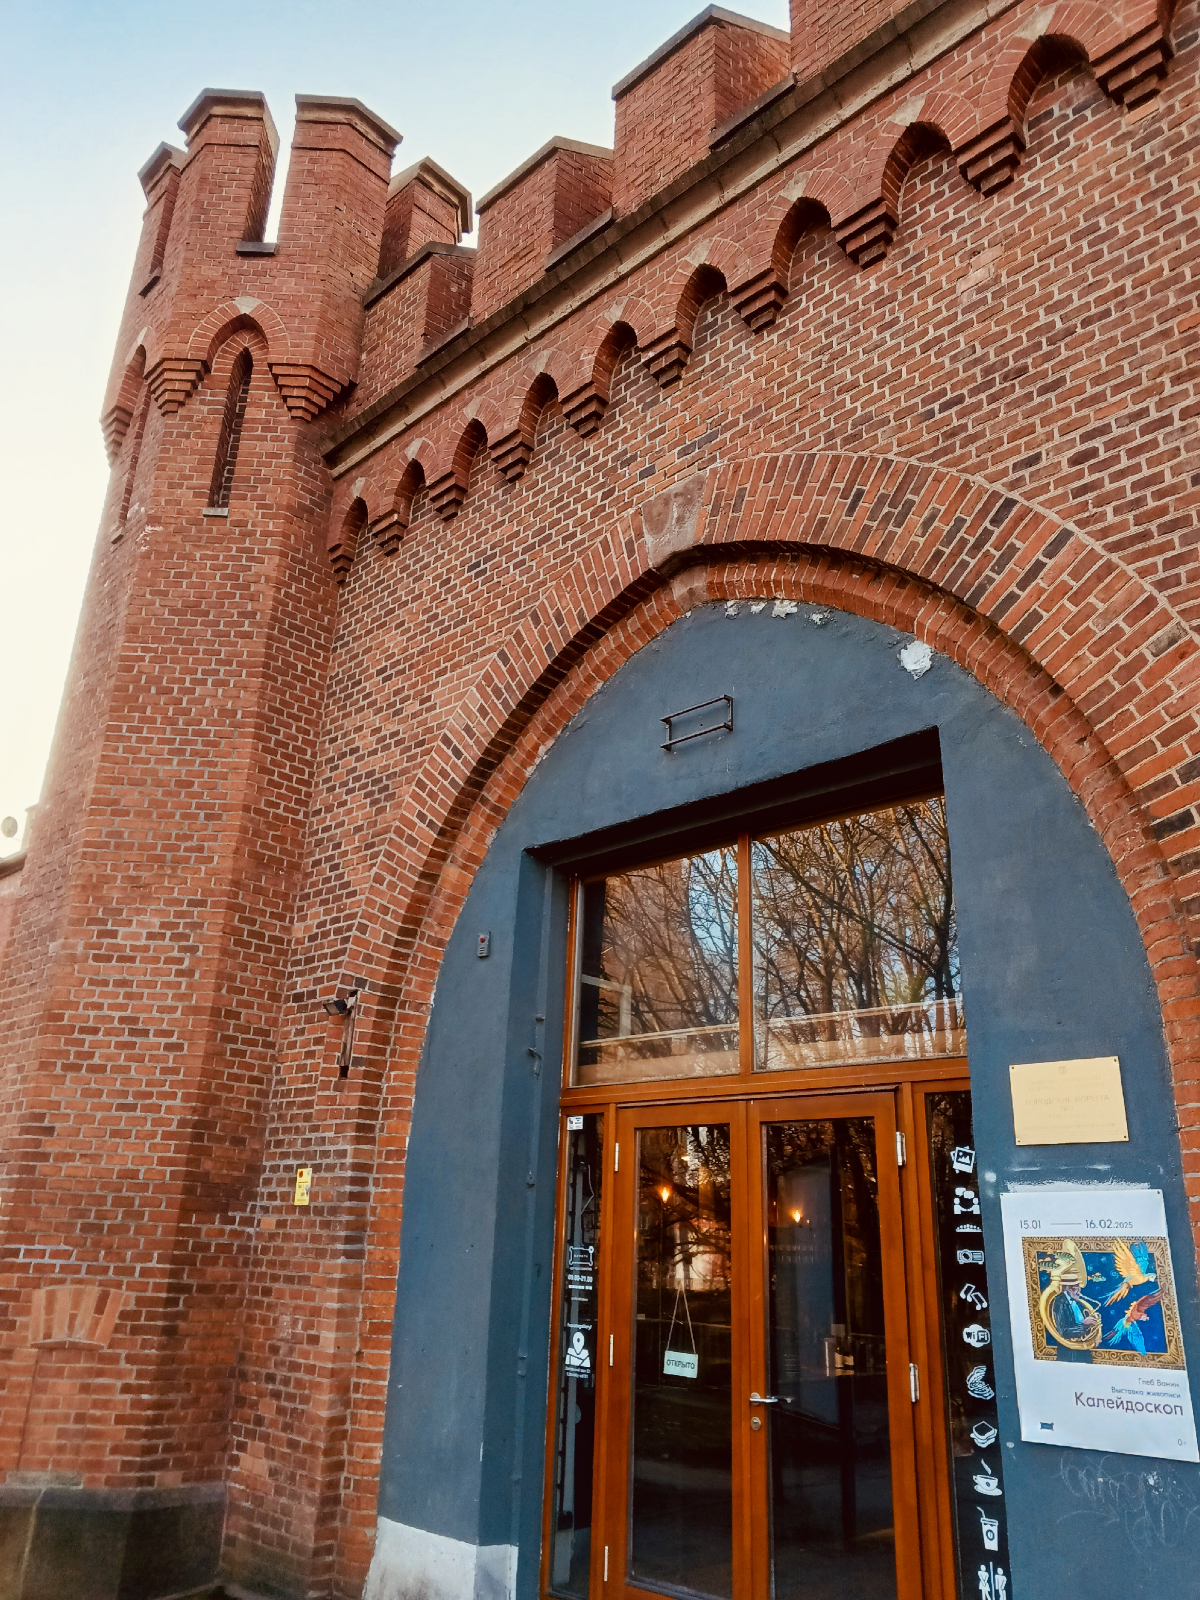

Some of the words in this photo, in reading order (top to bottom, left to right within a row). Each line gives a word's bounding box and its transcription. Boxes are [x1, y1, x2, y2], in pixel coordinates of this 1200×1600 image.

[1019, 1219, 1041, 1230] 15.01
[666, 1358, 695, 1370] ОТКРЫТО
[1111, 1386, 1144, 1396] Выставка
[1146, 1390, 1181, 1399] живописи
[1074, 1391, 1184, 1416] Калейдоскоп
